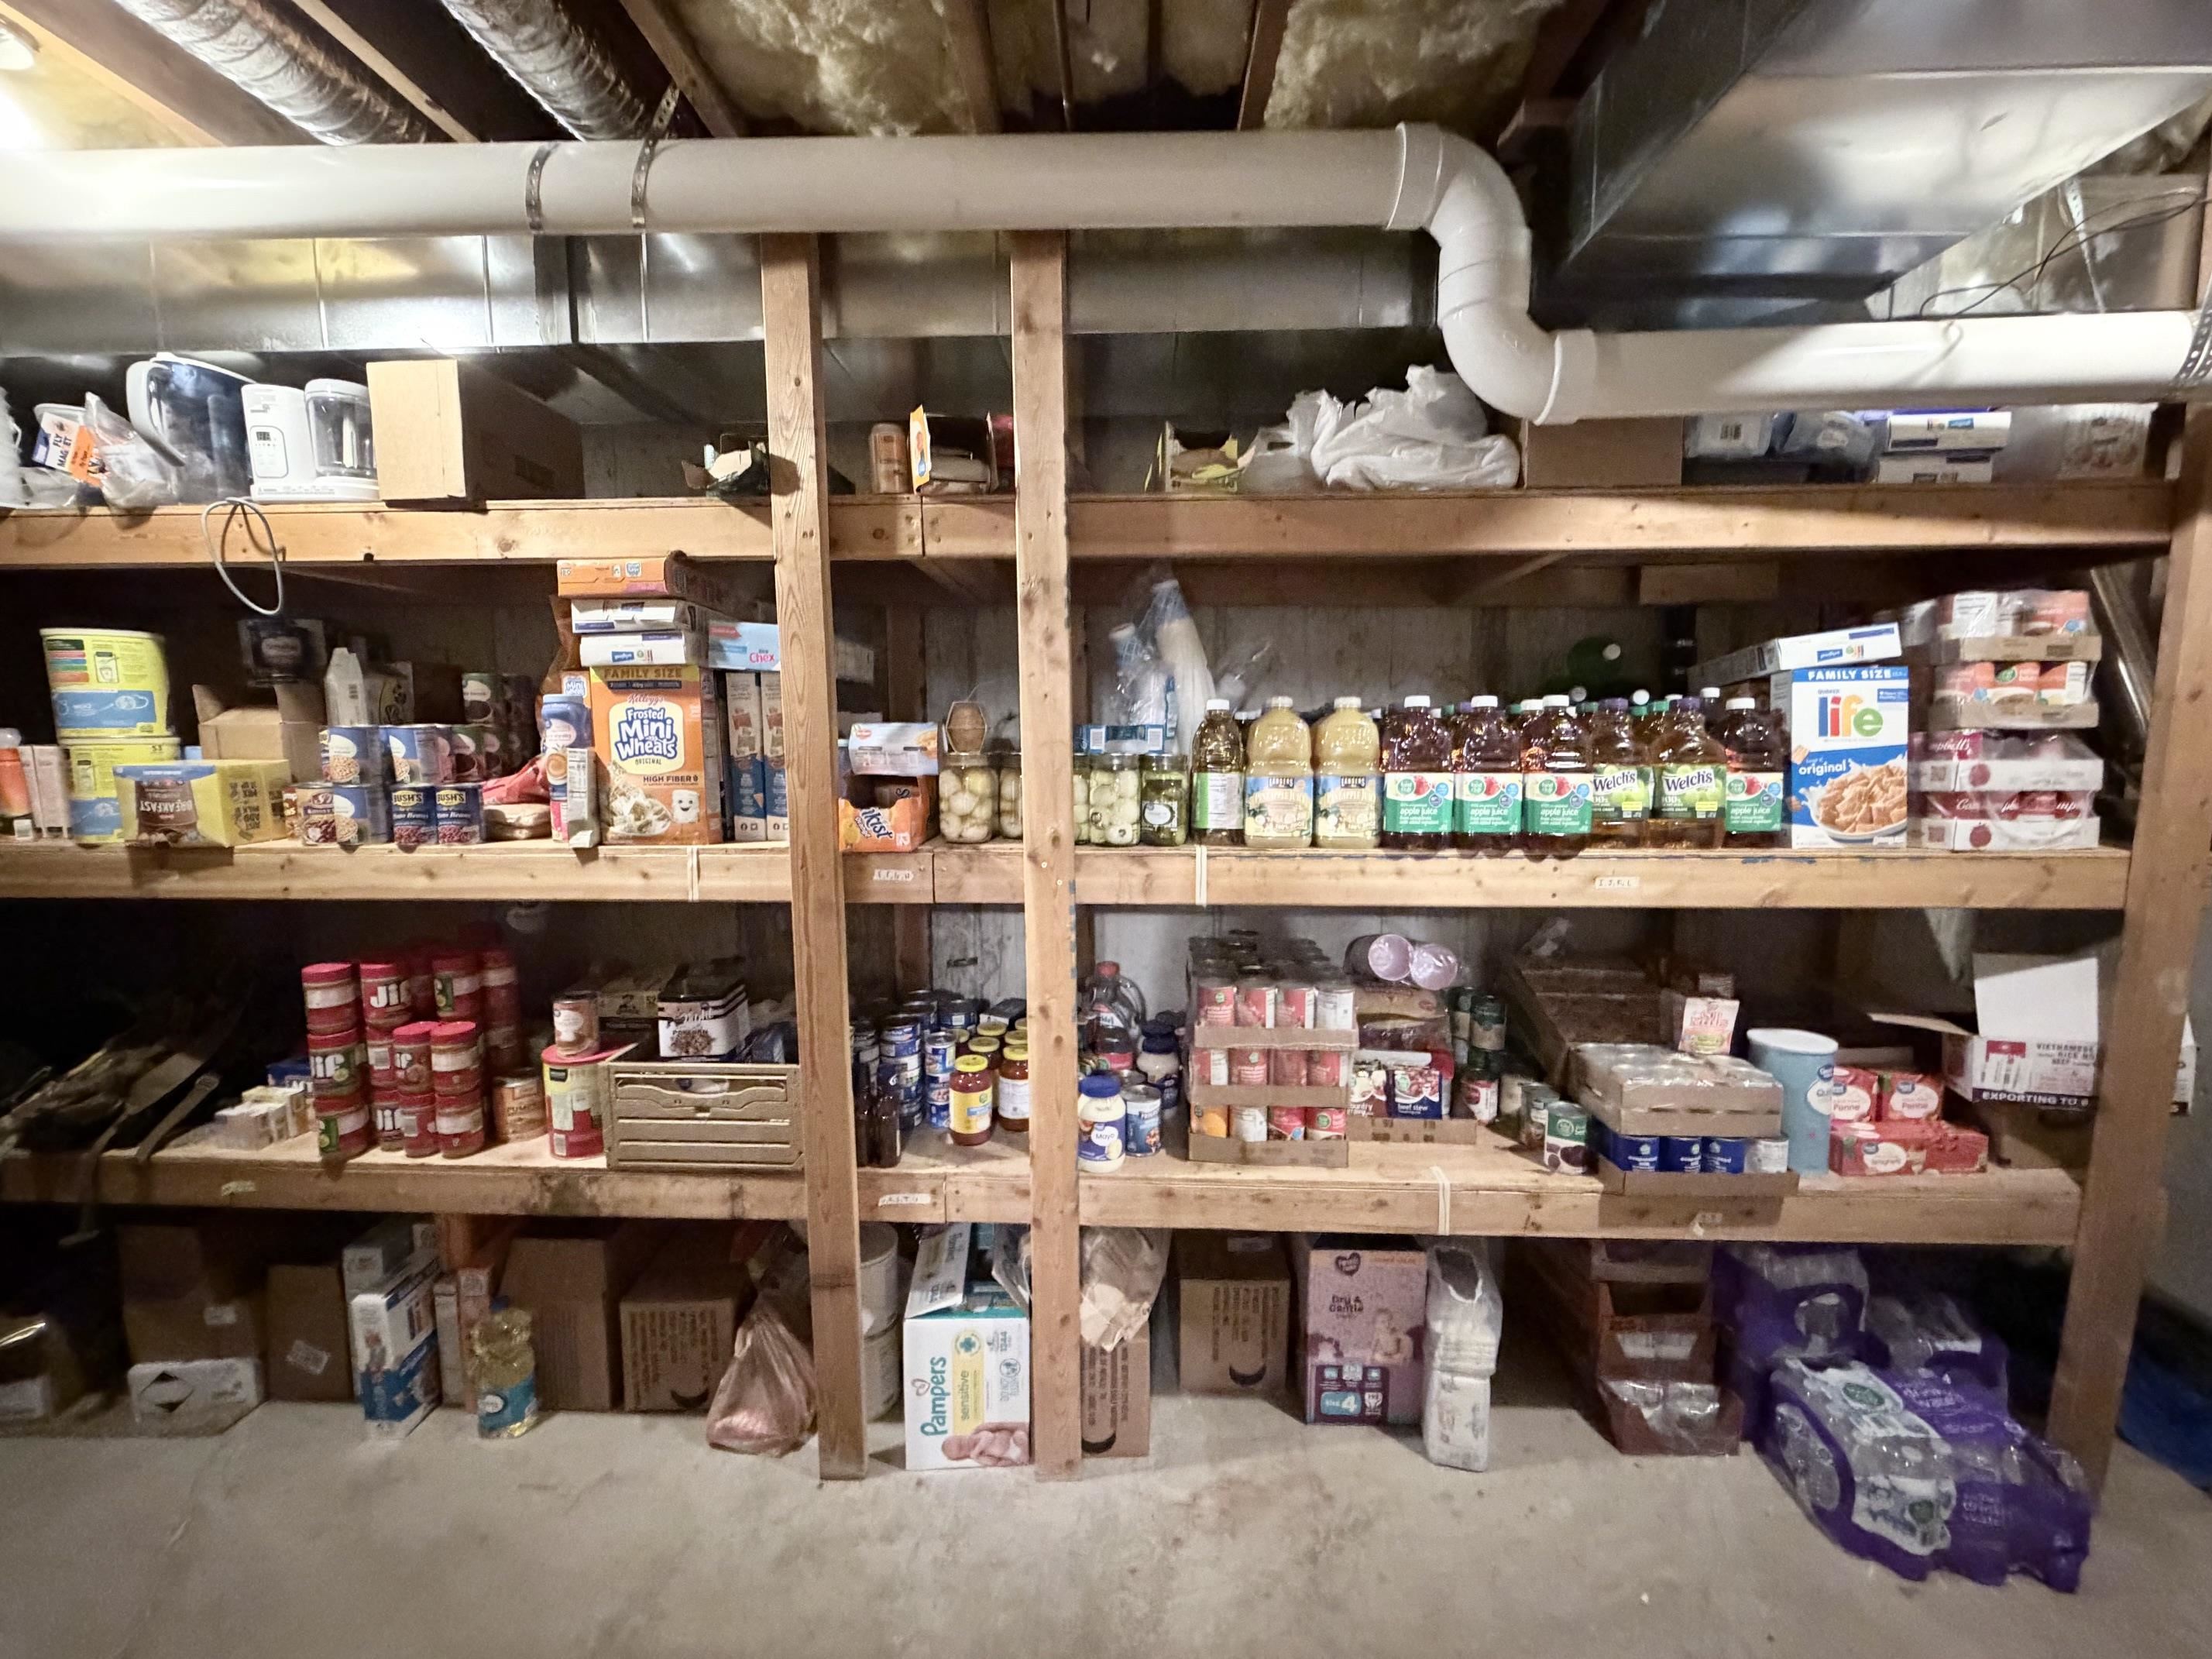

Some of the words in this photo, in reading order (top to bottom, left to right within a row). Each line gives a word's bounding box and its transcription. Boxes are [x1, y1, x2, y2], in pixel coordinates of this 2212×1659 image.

[53, 433, 63, 448] FLY
[57, 436, 72, 468] MAGET
[749, 652, 775, 664] Chex
[603, 667, 652, 679] FAMILY
[654, 667, 682, 678] SIZE
[1808, 669, 1857, 680] FAMILY
[1861, 668, 1891, 679] SIZE
[627, 694, 665, 707] Kellogg's
[626, 708, 666, 721] Frosted
[1818, 695, 1884, 737] life
[618, 718, 674, 741] Mini
[616, 737, 678, 761] Wheats
[1798, 760, 1847, 776] original
[1594, 771, 1637, 792] Welch's
[1665, 770, 1713, 792] Welch's
[393, 792, 423, 803] BUSH'S
[437, 792, 465, 802] BUSH'S
[139, 799, 193, 813] BREAKFAST
[1400, 807, 1420, 816] apple
[1420, 807, 1438, 816] juice
[1470, 807, 1491, 816] apple
[1492, 807, 1509, 816] juice
[1540, 808, 1561, 817] apple
[1561, 808, 1579, 816] juice
[1730, 808, 1751, 816] apple
[1982, 1091, 2057, 1105] EXPORTING
[2059, 1097, 2077, 1106] TO
[1095, 1132, 1115, 1141] Mayo
[920, 1356, 950, 1437] Pampers
[959, 1370, 970, 1420] sensitive
[1341, 1395, 1357, 1413] 4
